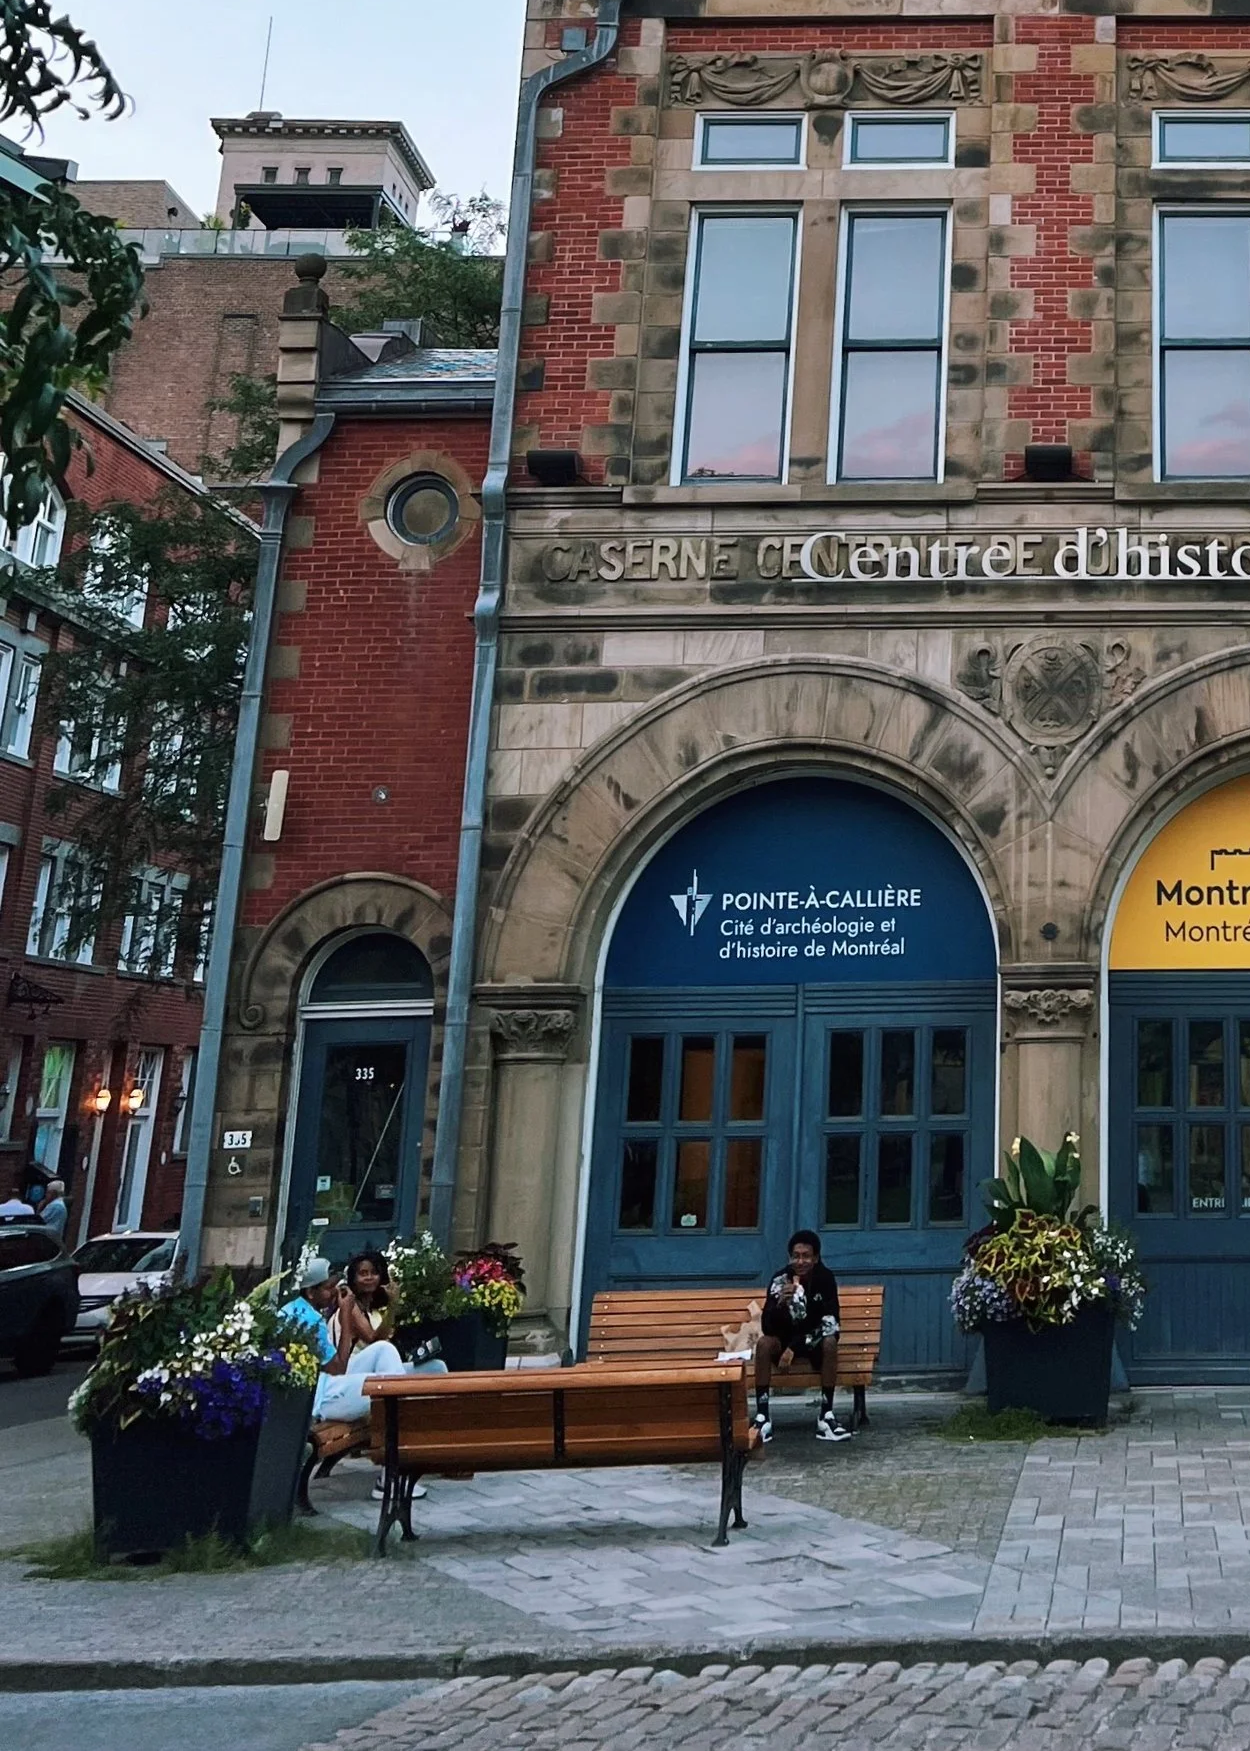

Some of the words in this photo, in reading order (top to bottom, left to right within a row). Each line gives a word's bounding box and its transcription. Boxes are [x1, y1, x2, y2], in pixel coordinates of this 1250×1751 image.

[542, 537, 739, 581] CASERNE
[990, 534, 1043, 575] DE
[800, 531, 1012, 580] Centre
[721, 884, 922, 911] POINTE-À-CALLIÈRE
[720, 918, 755, 936] Cité
[760, 916, 875, 938] d'archéologie
[880, 916, 896, 933] et
[719, 941, 798, 959] d'histoire
[803, 939, 826, 957] de
[831, 937, 905, 957] Montréal
[355, 1067, 375, 1080] 335
